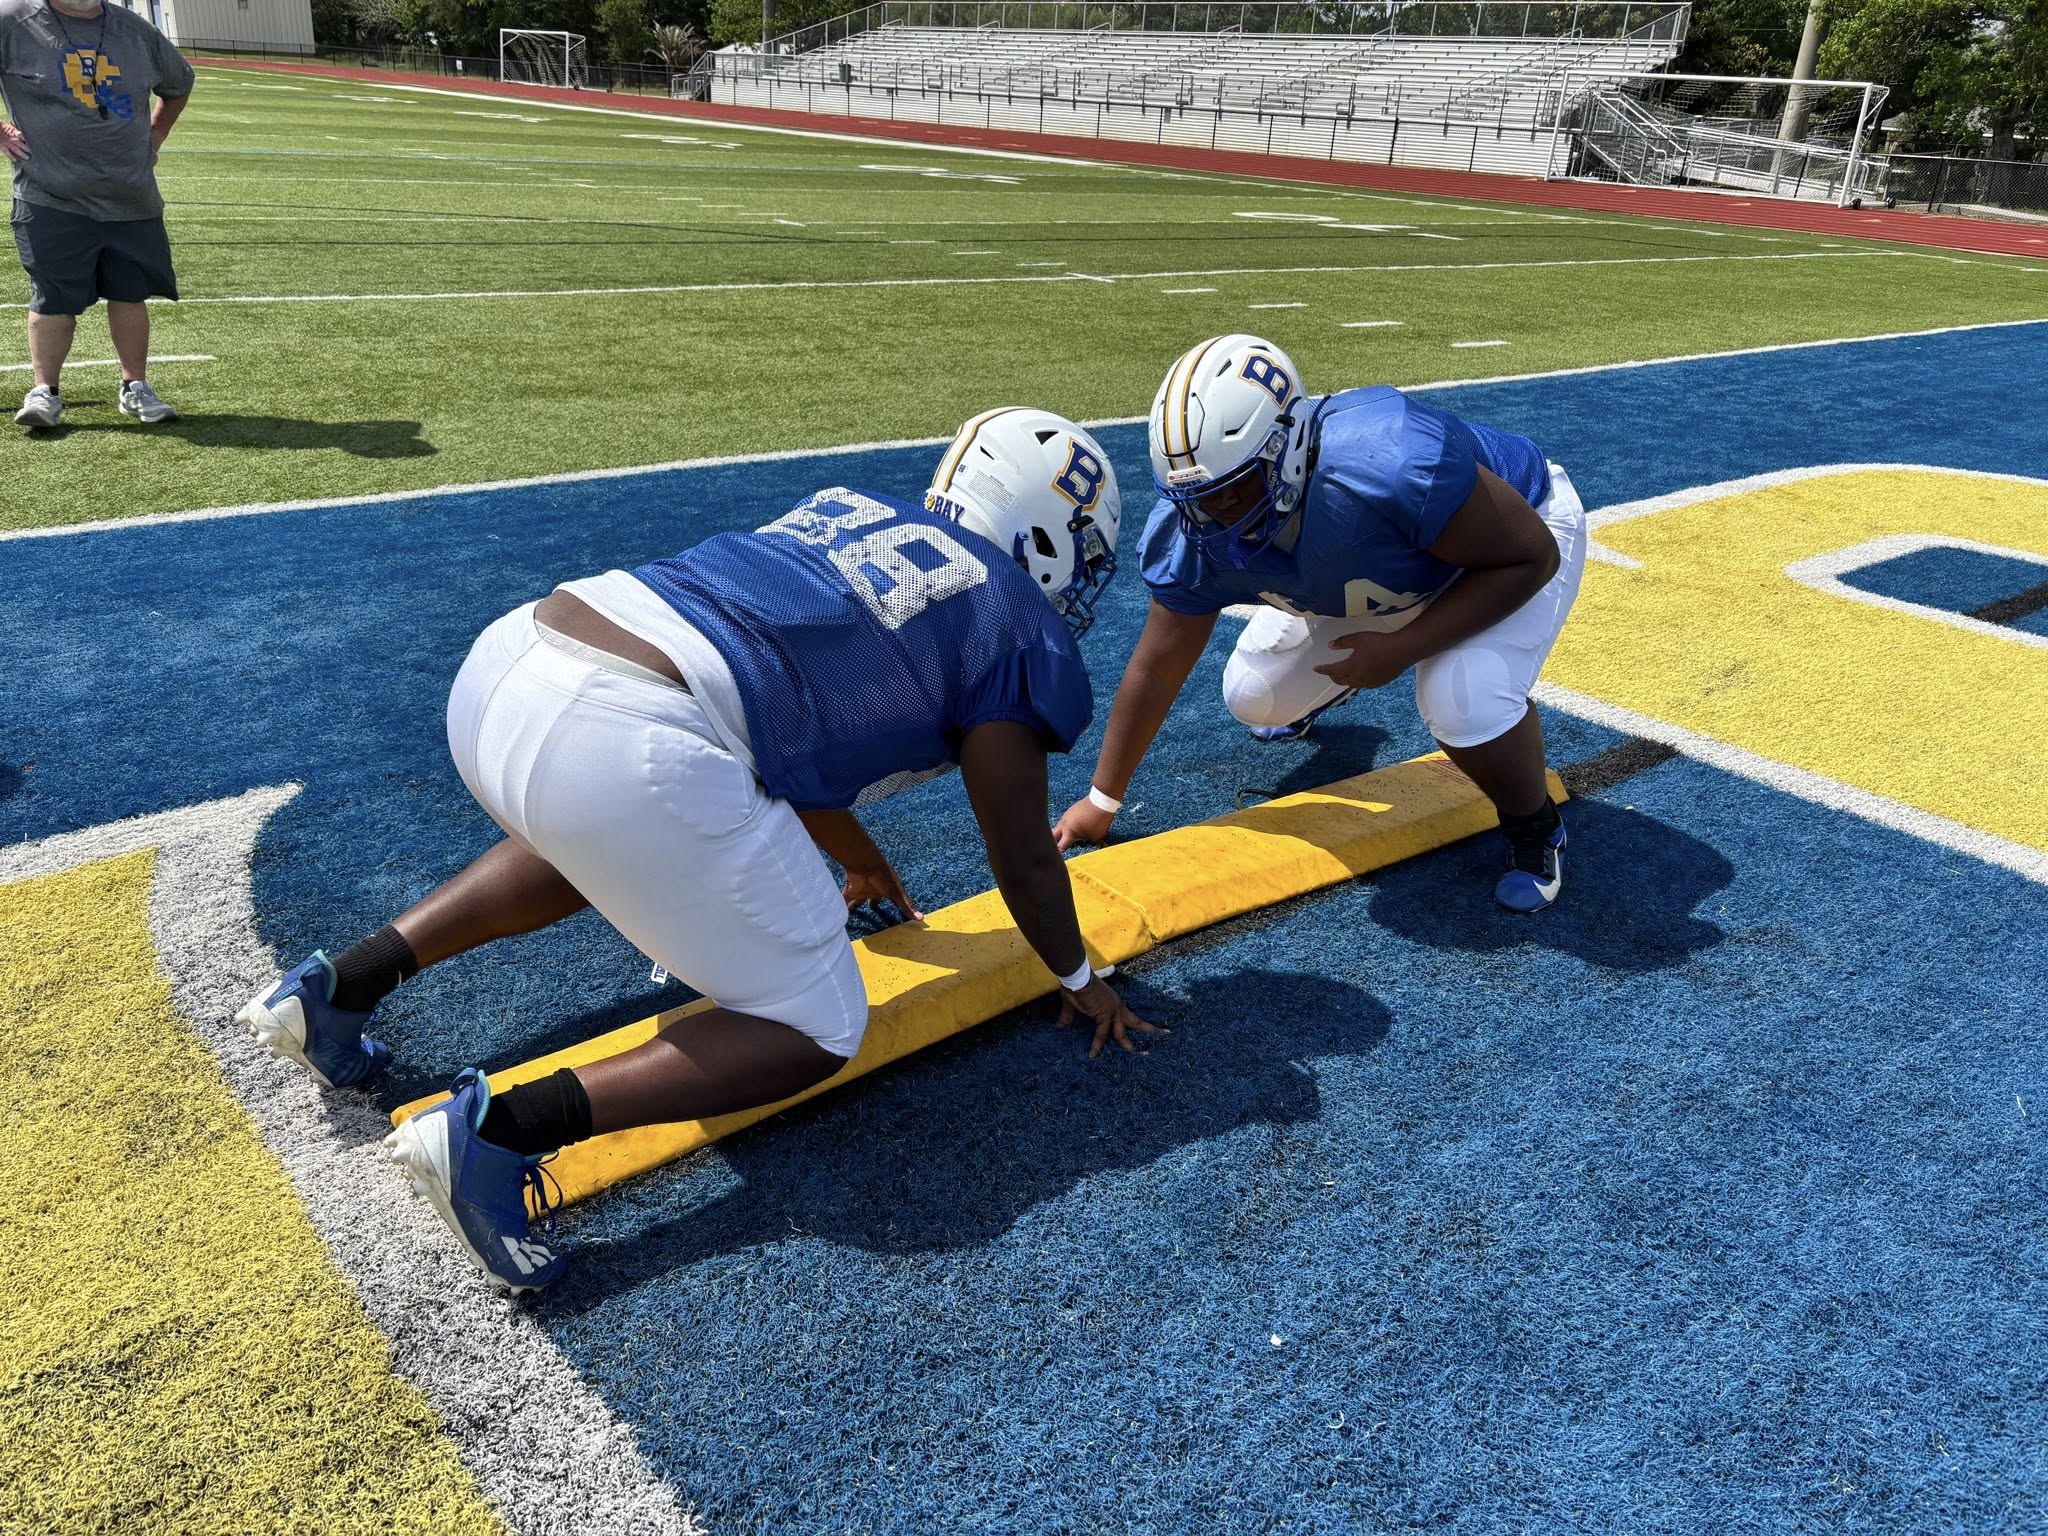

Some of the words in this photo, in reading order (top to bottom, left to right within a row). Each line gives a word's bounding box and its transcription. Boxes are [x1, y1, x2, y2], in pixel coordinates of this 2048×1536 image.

[1238, 354, 1293, 410] B
[1050, 437, 1106, 511] B
[933, 494, 965, 524] BAY
[754, 486, 989, 631] 88
